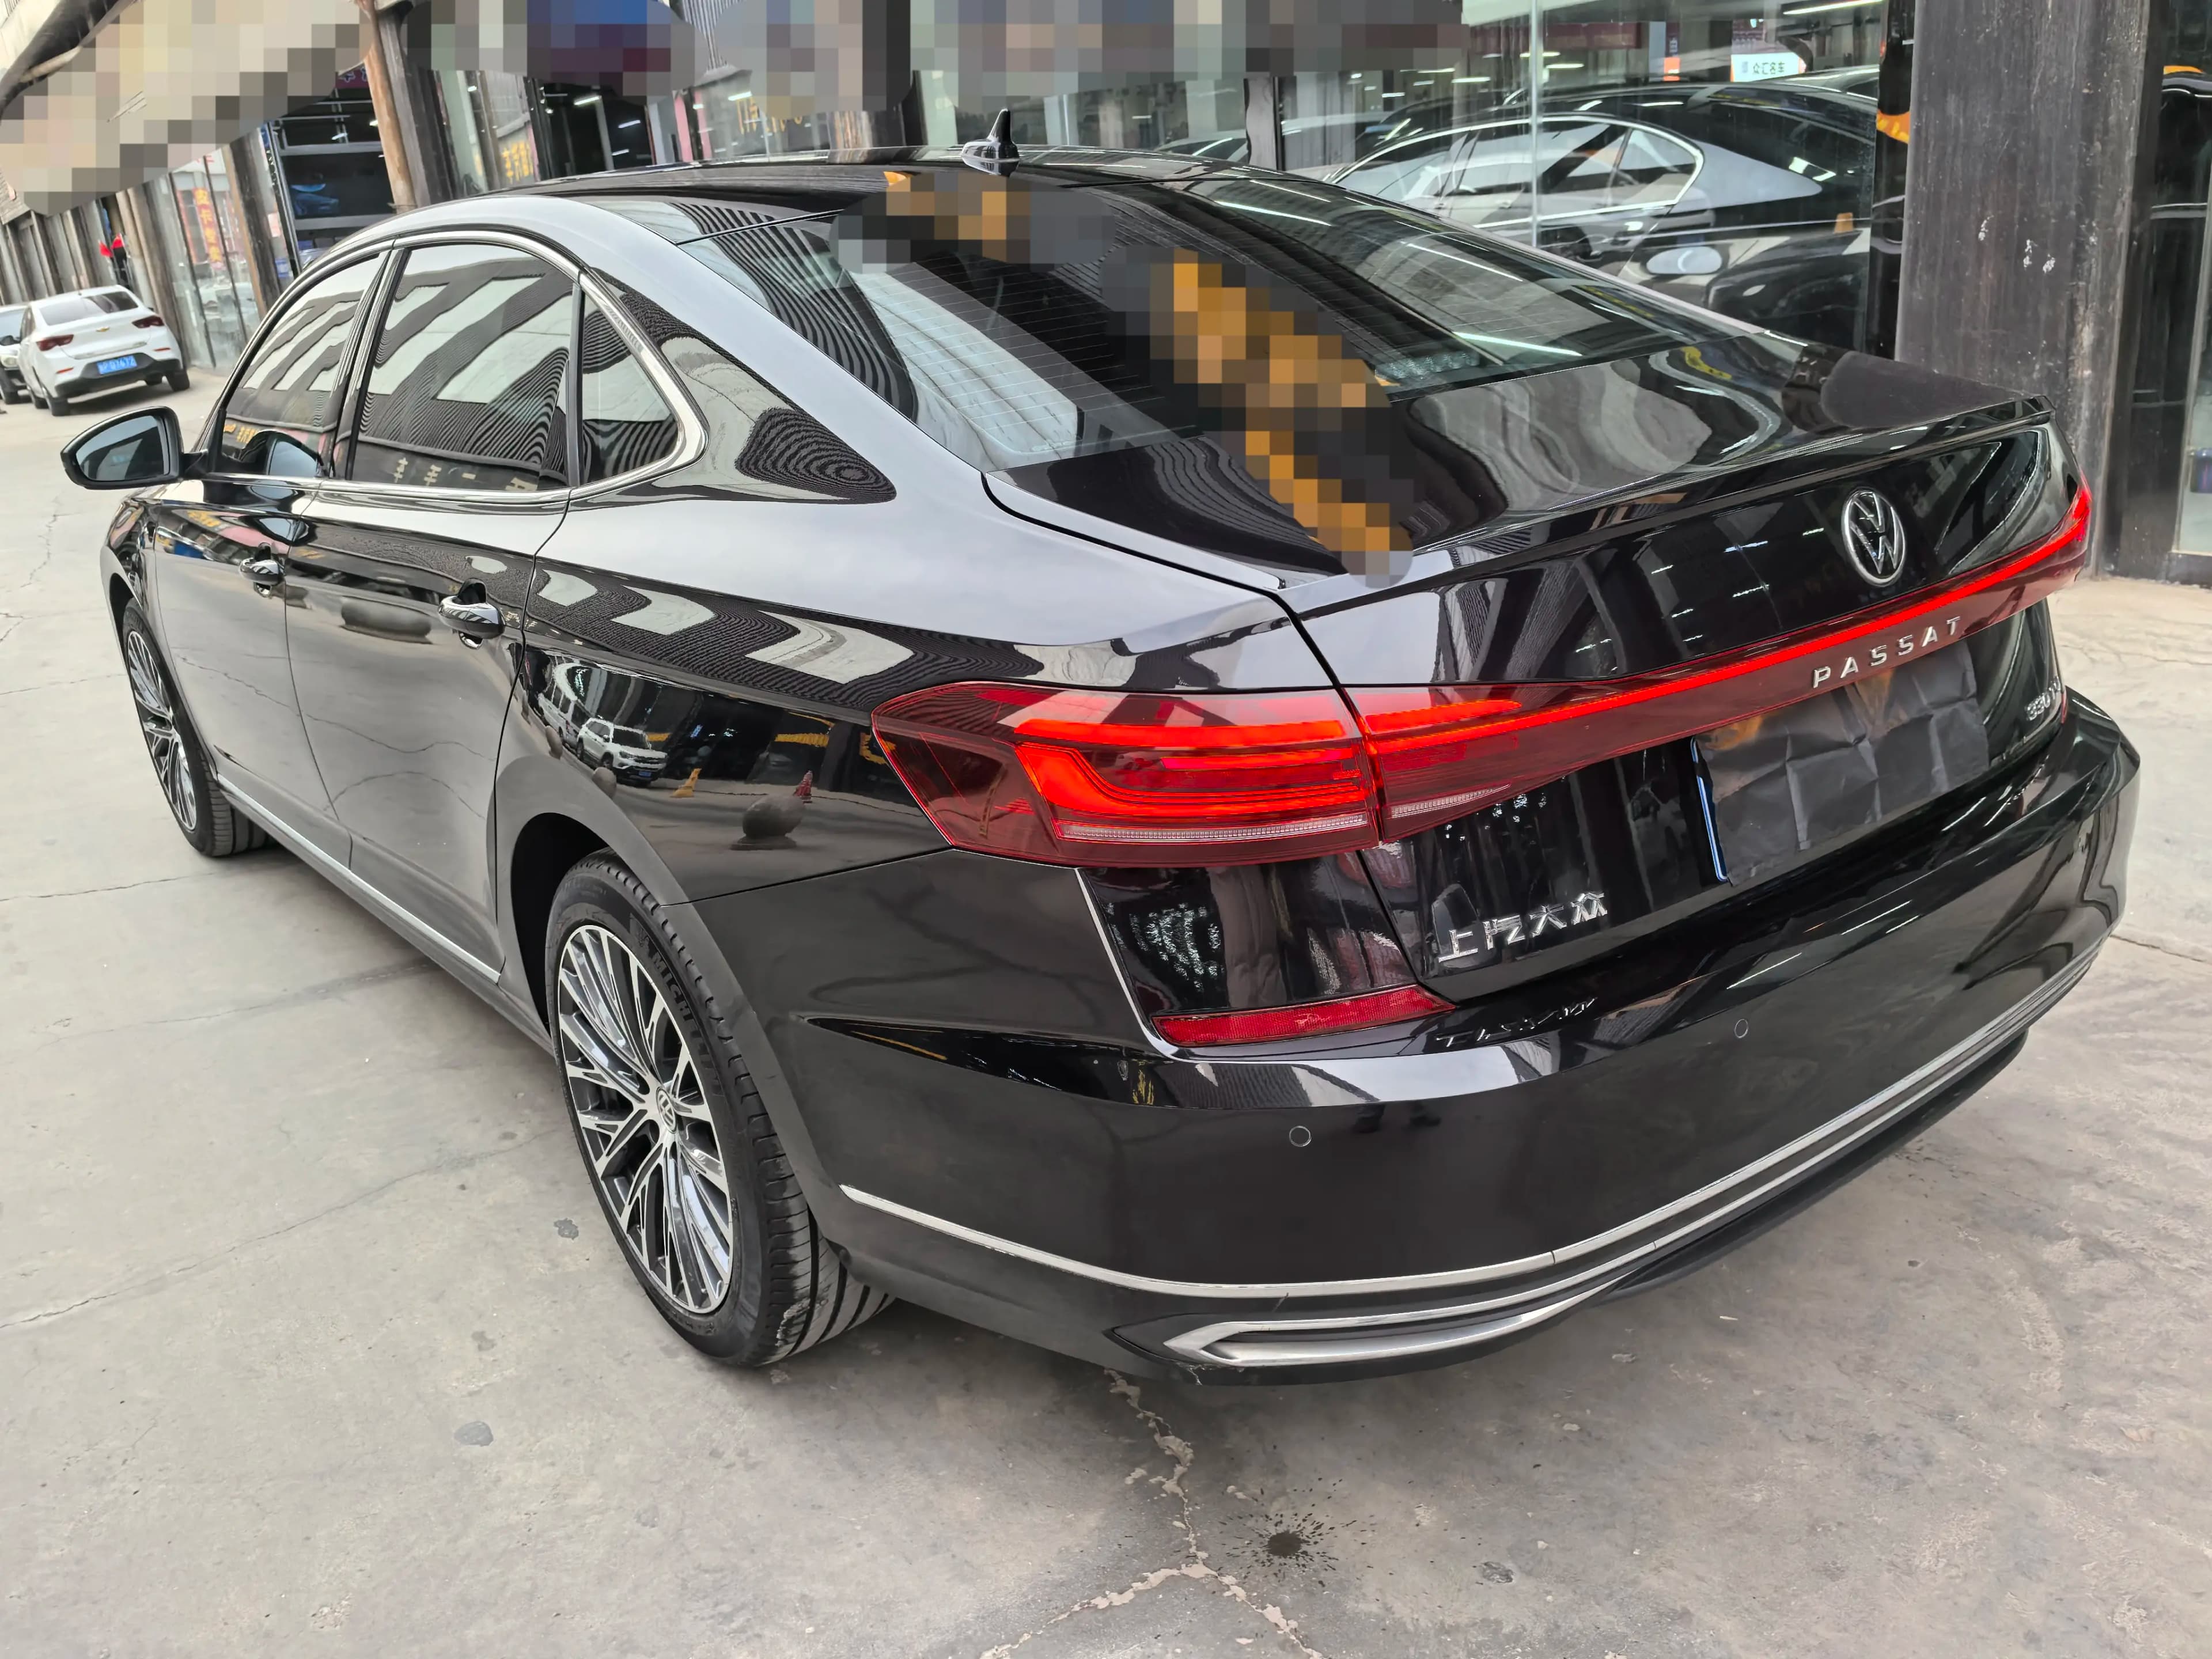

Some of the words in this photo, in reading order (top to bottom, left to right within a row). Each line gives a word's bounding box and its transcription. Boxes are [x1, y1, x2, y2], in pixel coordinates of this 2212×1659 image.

[1813, 616, 1961, 688] PASSAT
[1438, 892, 1608, 963] 上汽大众
